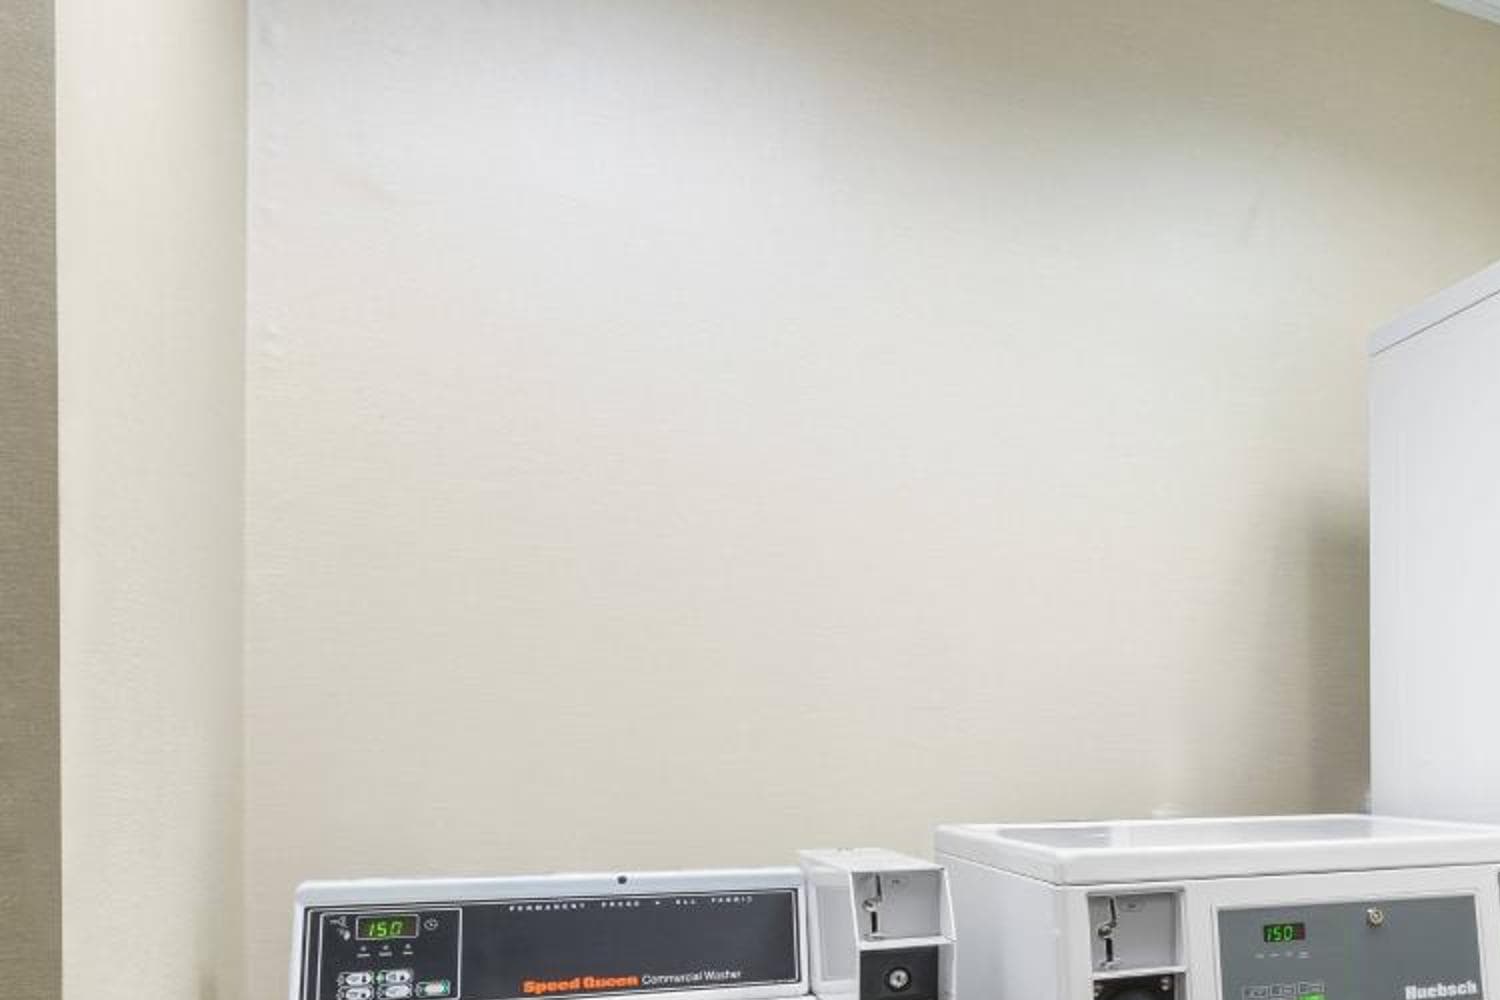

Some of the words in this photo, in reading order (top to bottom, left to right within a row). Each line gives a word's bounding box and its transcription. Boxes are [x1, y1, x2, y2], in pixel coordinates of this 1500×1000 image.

[367, 920, 404, 938] 150
[1265, 925, 1296, 942] 150
[522, 976, 581, 994] Speed
[583, 975, 640, 989] Queen
[1404, 980, 1478, 1000] Huebsch
